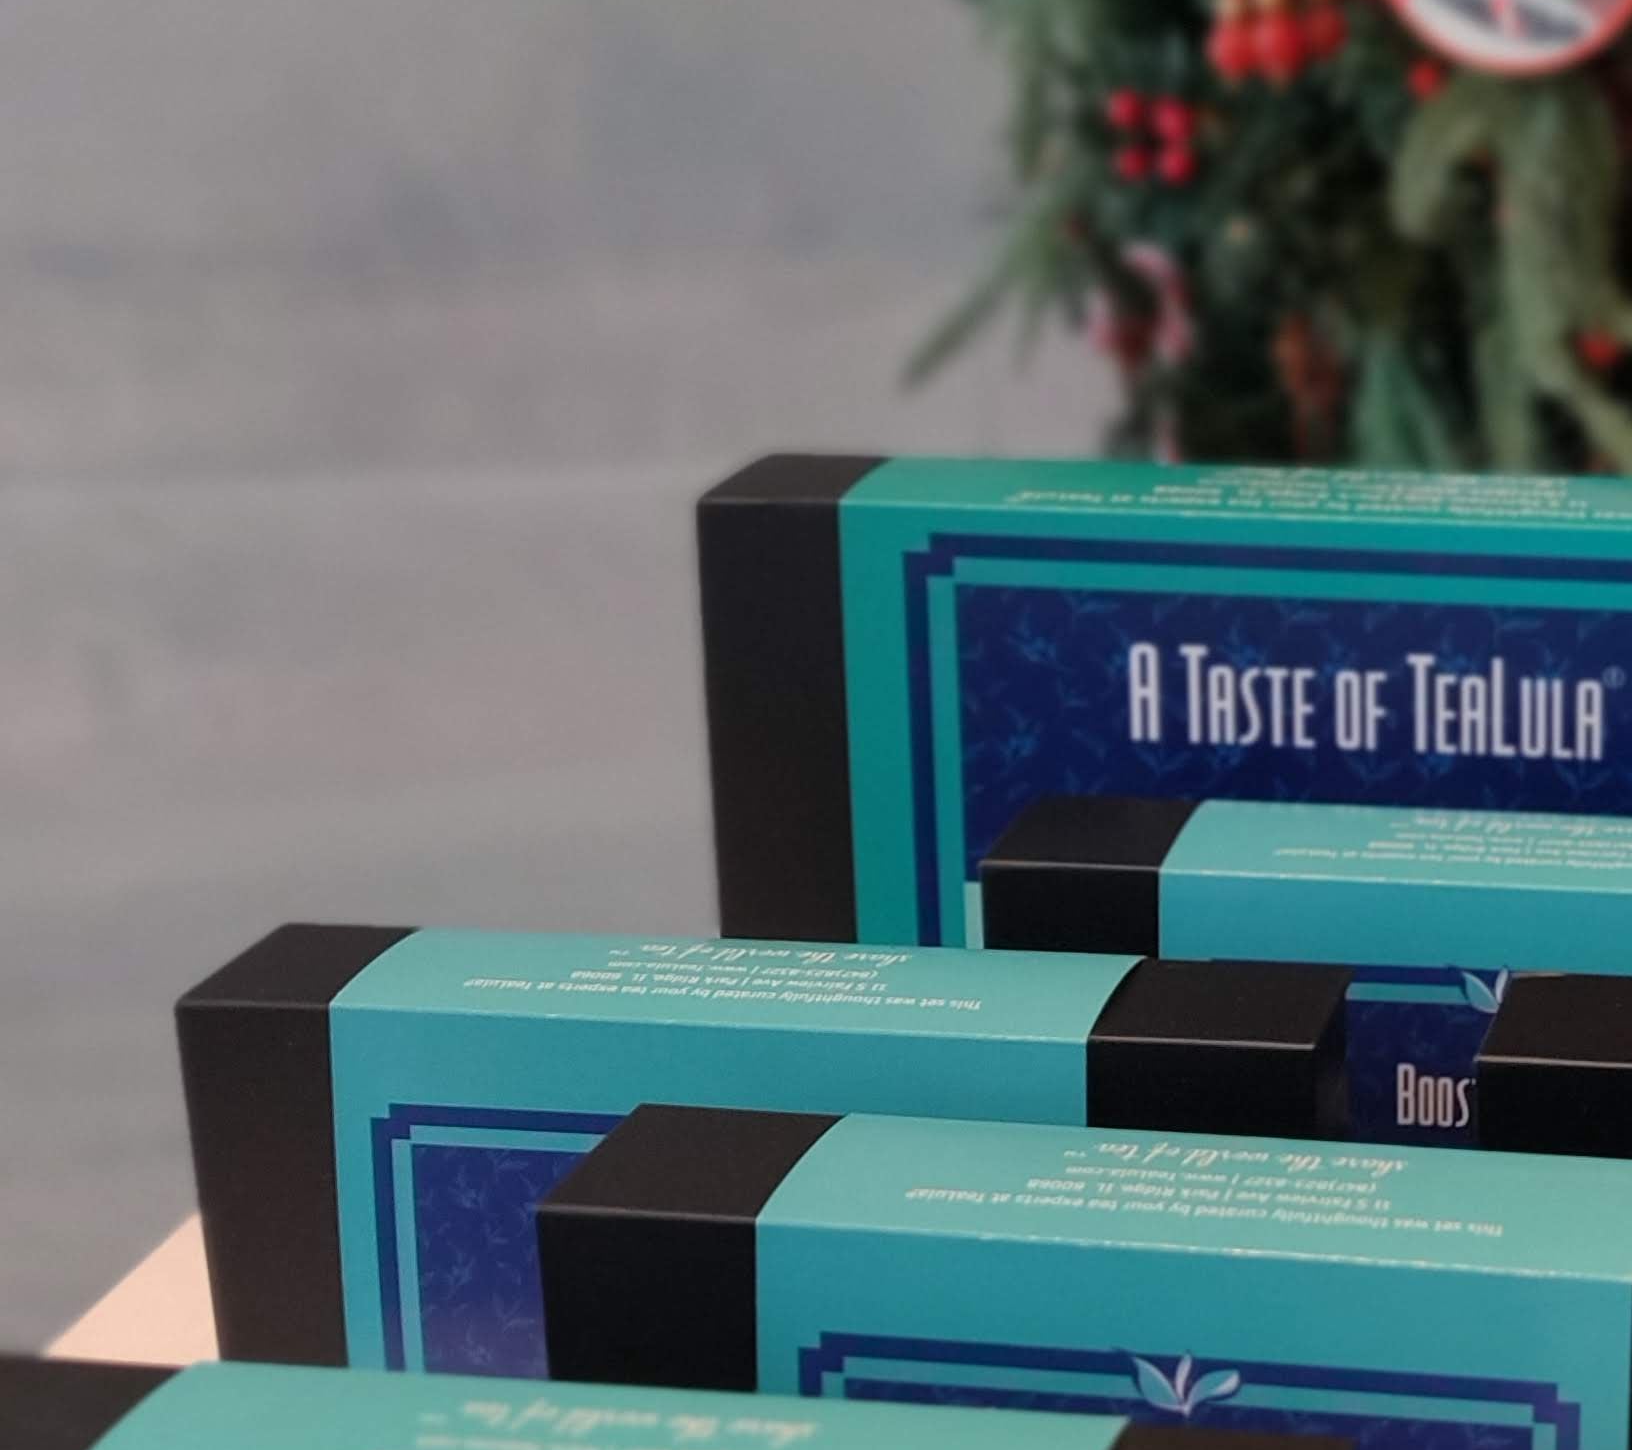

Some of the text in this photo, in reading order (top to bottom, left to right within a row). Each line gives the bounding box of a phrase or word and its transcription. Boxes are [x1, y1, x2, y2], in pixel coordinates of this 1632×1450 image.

[1128, 642, 1161, 742] A
[1178, 644, 1317, 748] TASTE
[1397, 1062, 1477, 1128] BOOS
